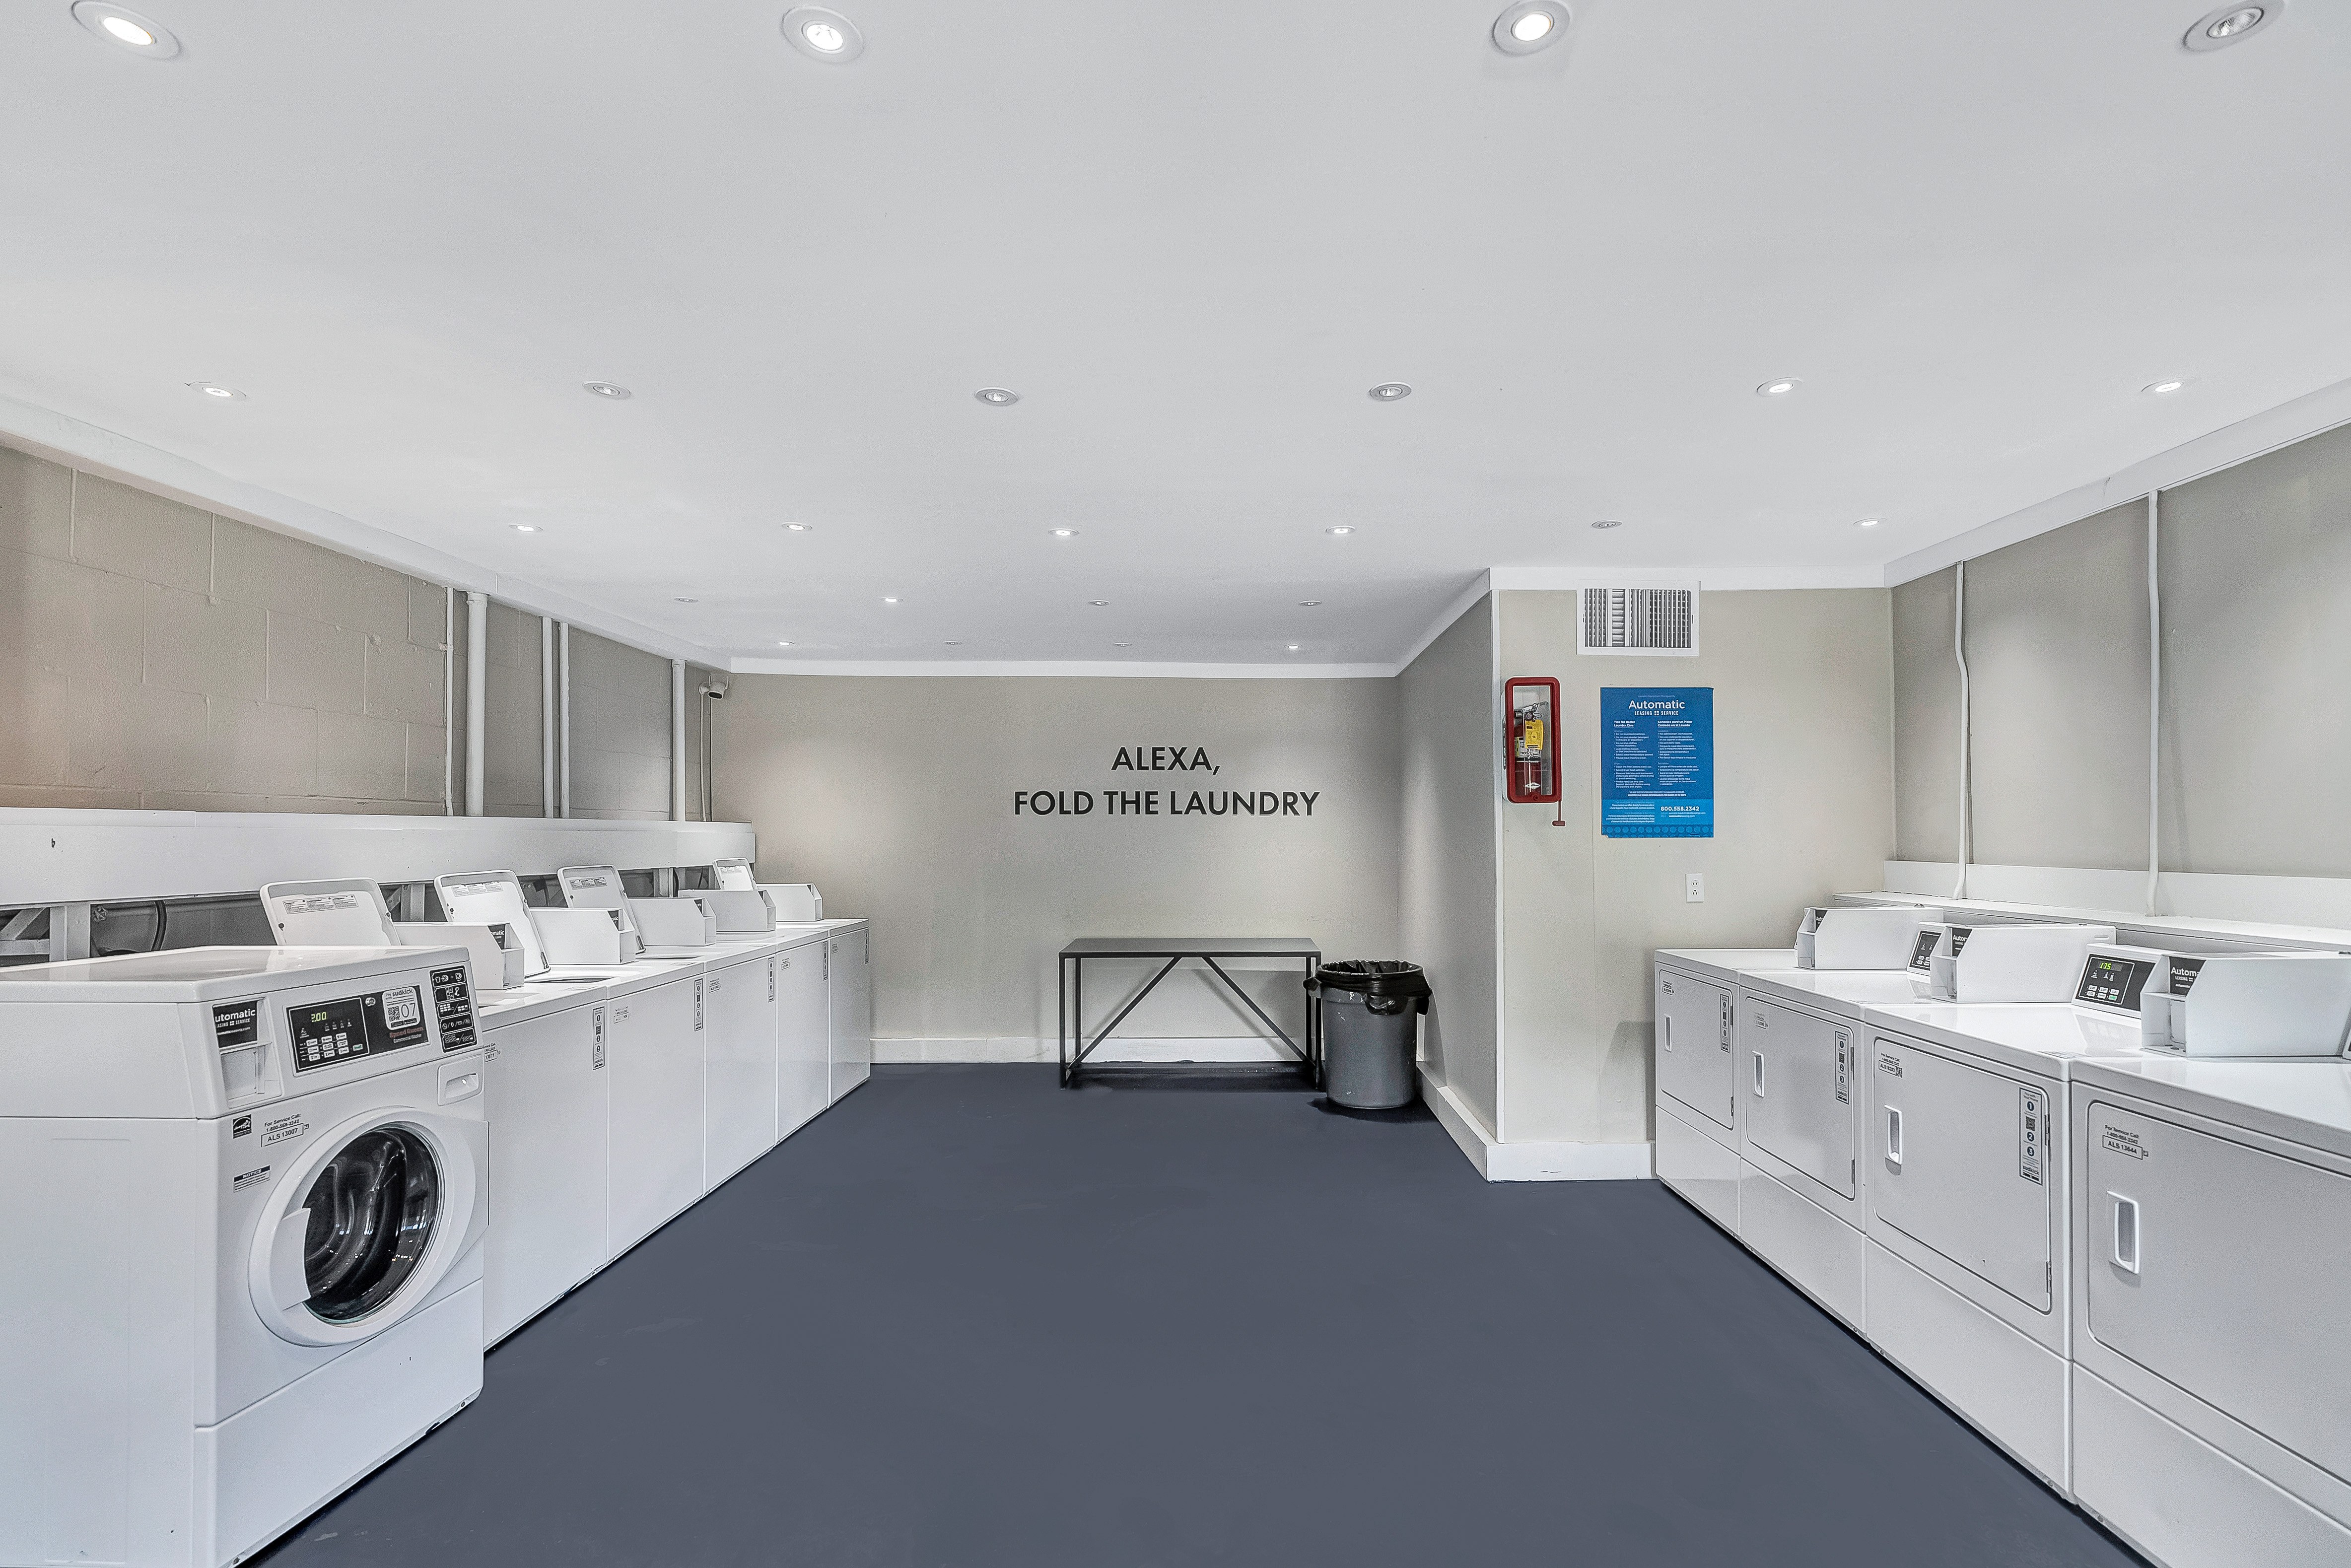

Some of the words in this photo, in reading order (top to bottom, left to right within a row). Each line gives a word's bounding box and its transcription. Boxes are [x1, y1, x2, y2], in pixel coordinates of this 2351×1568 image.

[1628, 700, 1685, 709] Automatic
[1111, 747, 1221, 775] ALEXA,
[1014, 790, 1094, 816] FOLD
[1104, 791, 1159, 815] THE
[1170, 791, 1320, 817] LAUNDRY
[392, 988, 413, 997] sudkick
[215, 1009, 256, 1023] utomatic
[401, 1002, 416, 1018] 07
[268, 1133, 280, 1142] ALS
[281, 1127, 299, 1137] 13007
[2108, 1141, 2120, 1149] ALS
[242, 1169, 262, 1179] NOTICE
